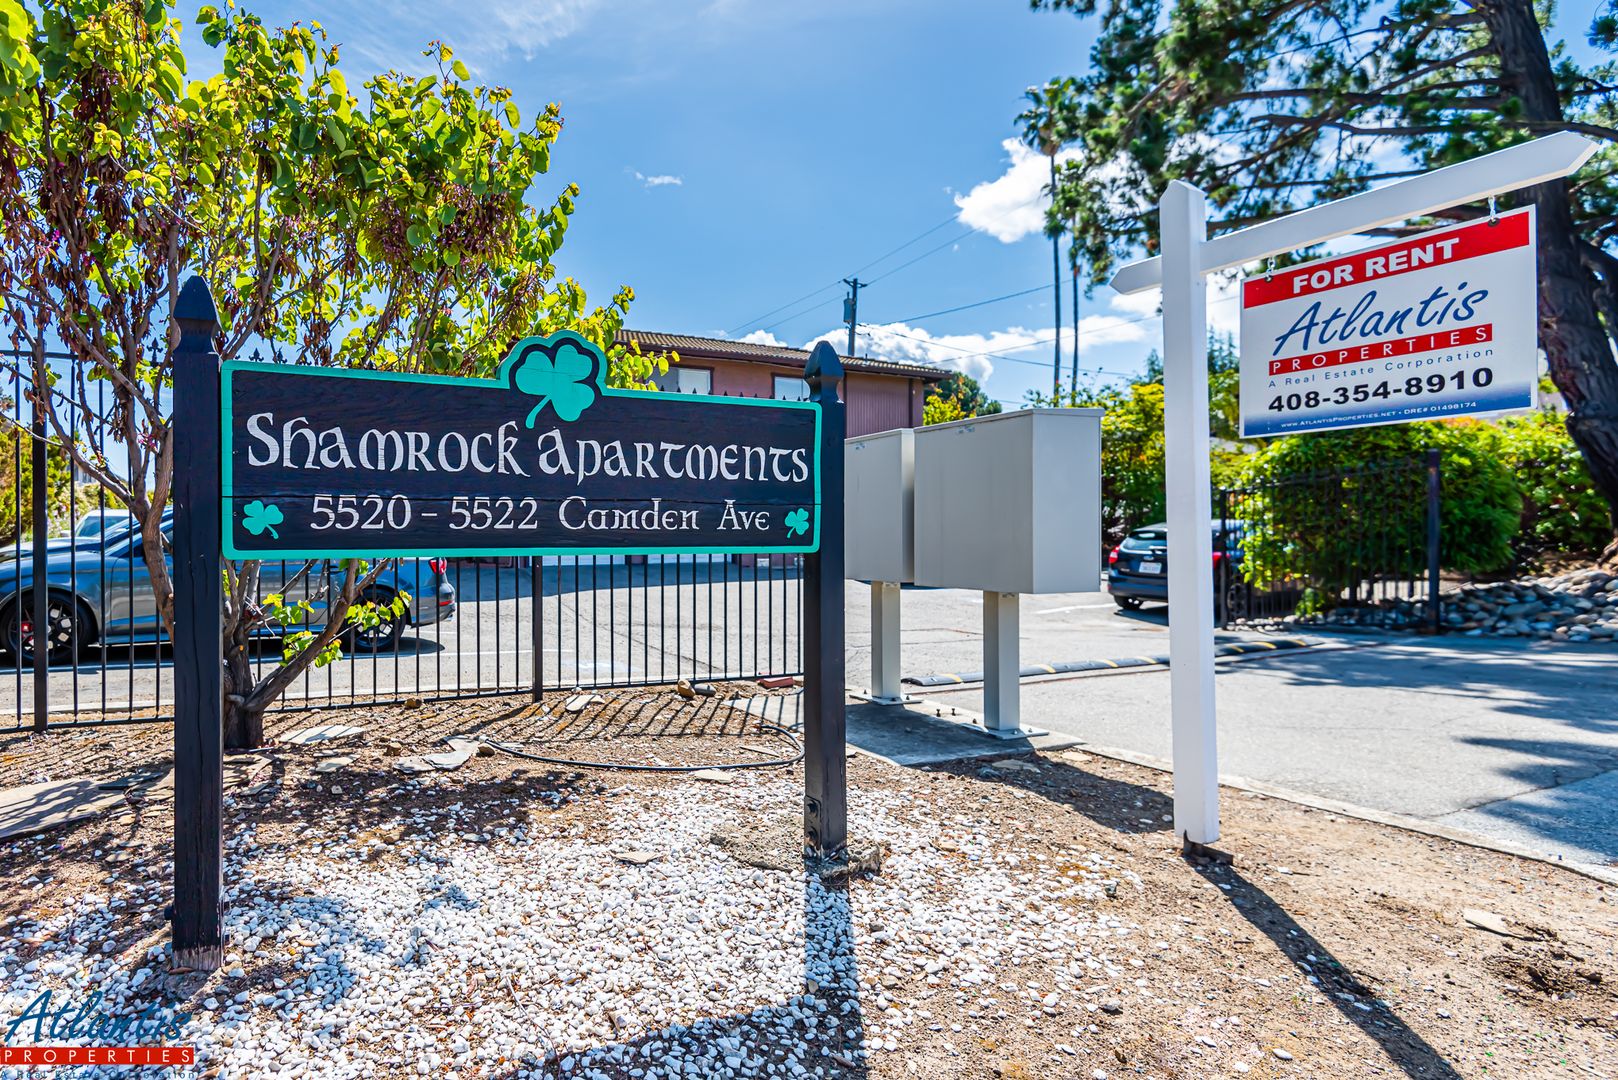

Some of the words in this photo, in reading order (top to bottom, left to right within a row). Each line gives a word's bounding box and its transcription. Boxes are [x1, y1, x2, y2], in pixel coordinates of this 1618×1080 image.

[1293, 264, 1355, 295] FOR
[1365, 237, 1460, 277] RENT
[1272, 281, 1490, 357] Atlantis
[1268, 380, 1276, 389] A
[1285, 374, 1316, 386] Real
[1325, 366, 1375, 381] Estate
[1384, 349, 1494, 372] Corporation
[1272, 327, 1488, 373] PROPERTIES
[1268, 367, 1494, 413] 408-354-8910
[310, 493, 412, 530] 5520
[449, 496, 539, 530] 5522
[558, 495, 700, 531] Camden
[716, 498, 771, 531] Ave
